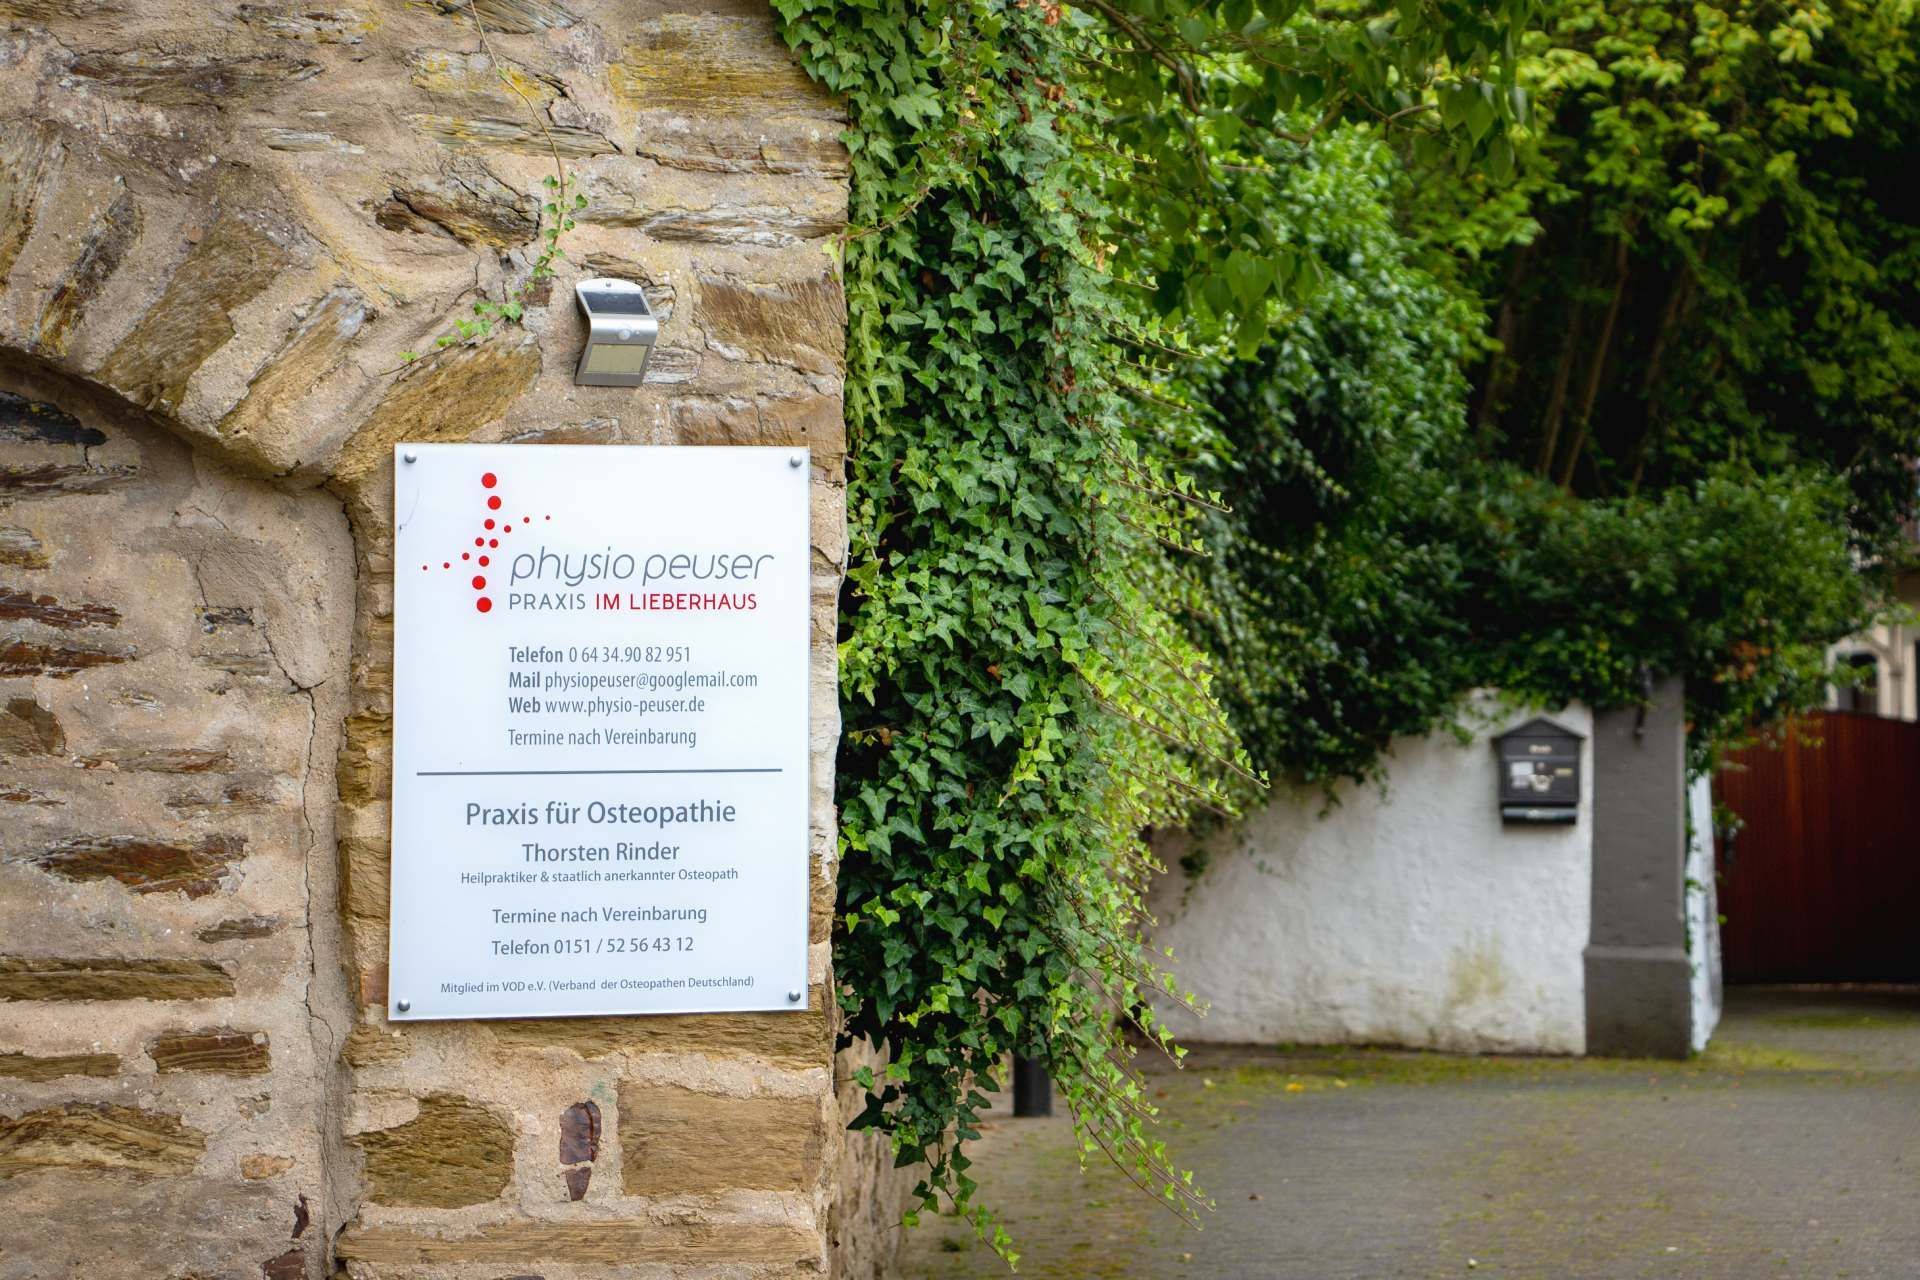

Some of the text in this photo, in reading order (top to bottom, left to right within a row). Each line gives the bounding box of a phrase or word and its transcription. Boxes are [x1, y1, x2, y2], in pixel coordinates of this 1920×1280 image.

[510, 546, 774, 587] physio peuser
[510, 593, 757, 610] PRAXIS IM LIEBERHAUS
[509, 646, 689, 663] Telefon 0 64 34.90 82 951
[509, 671, 757, 692] Mail physiopeuser@googlemail.com
[509, 696, 704, 717] Web www.physio-peuser.de
[508, 728, 696, 748] Termine nach Vereinbarung
[467, 799, 735, 829] Praxis für Osteopathie
[522, 841, 680, 862] Thorsten Rinder
[462, 868, 738, 886] Heilpraktiker & staatlich anerkannter Osteopath
[492, 906, 706, 923] Termine nach Vereinbarung
[492, 937, 693, 955] Telefon 0151 / 52 56 43 12
[441, 976, 753, 995] Mitglied im VOD e.V. (Verband der Osteopathen Deutschland)
